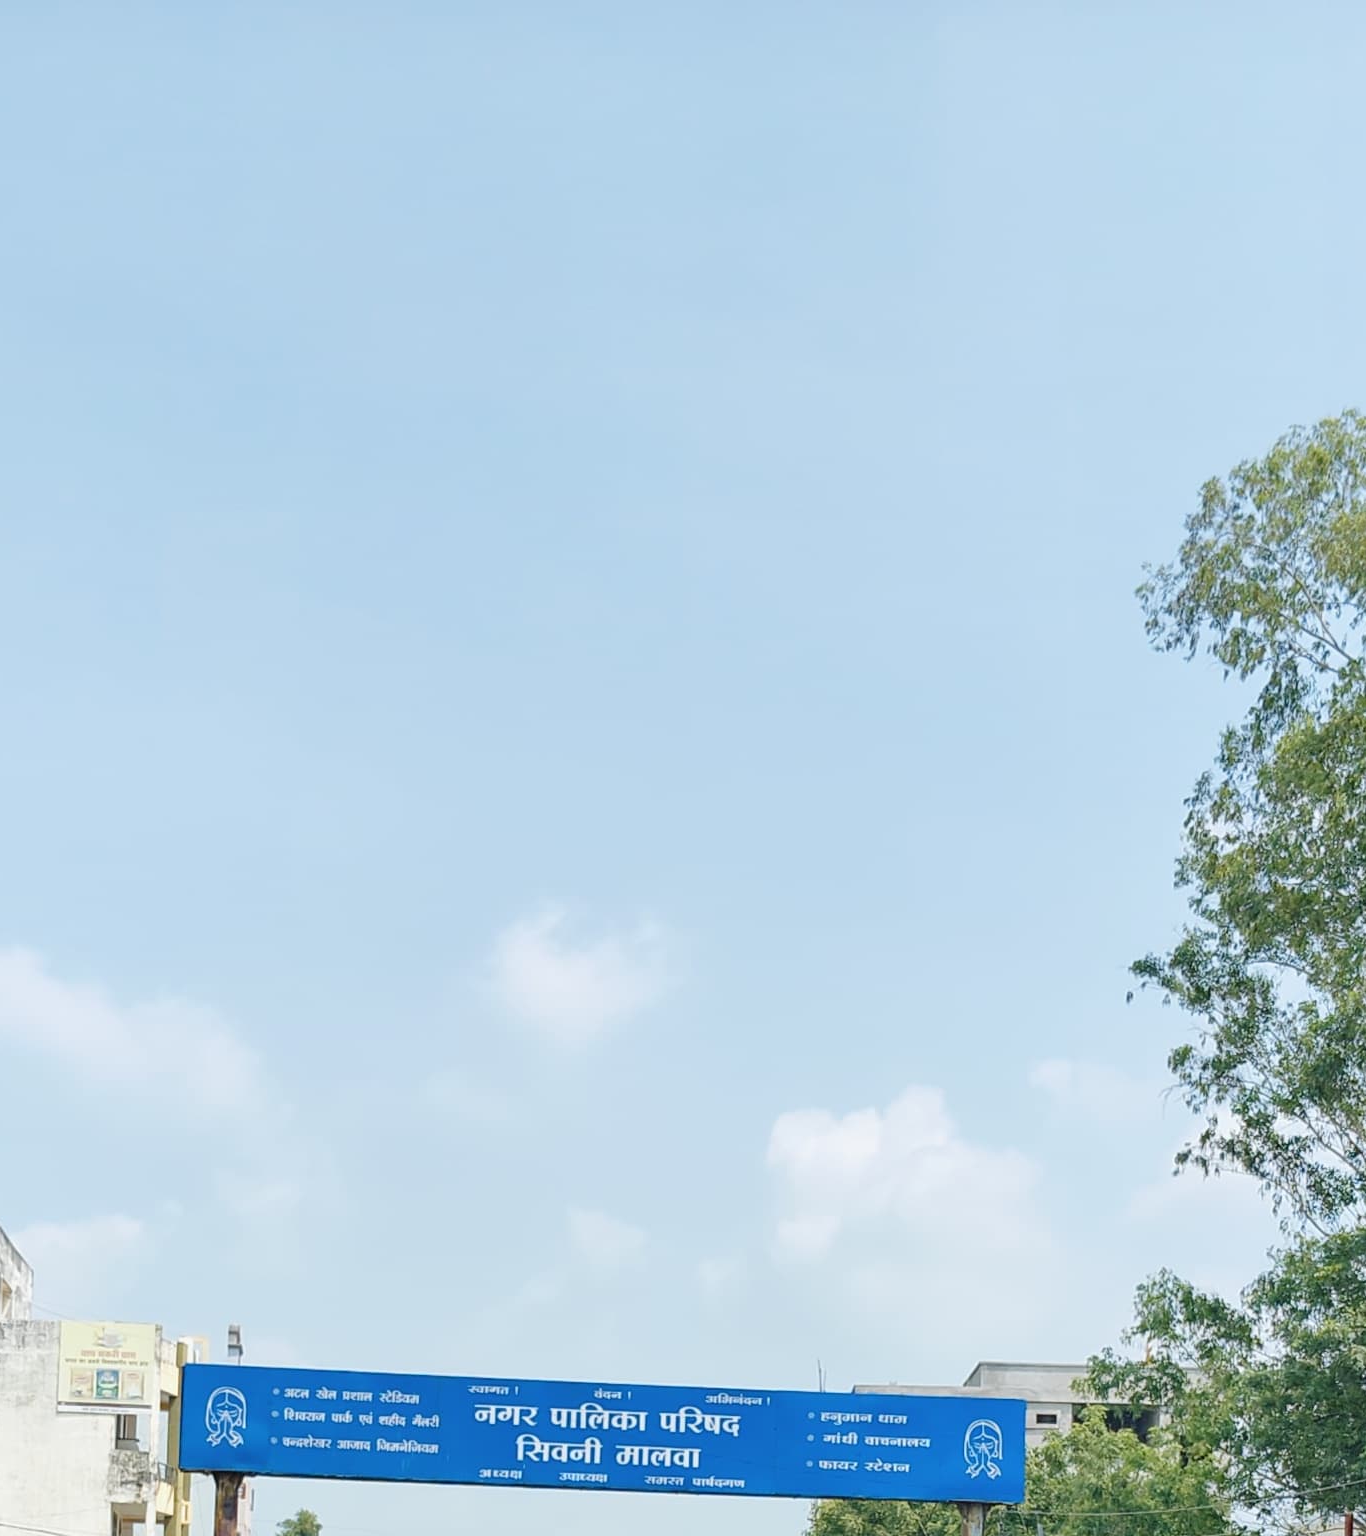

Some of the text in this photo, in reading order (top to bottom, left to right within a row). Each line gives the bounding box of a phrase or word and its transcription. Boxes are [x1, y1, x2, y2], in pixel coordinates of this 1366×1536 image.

[284, 1388, 309, 1399] अटल
[315, 1386, 337, 1400] खेल
[379, 1389, 420, 1405] स्टेडियम
[467, 1385, 510, 1395] स्वागत
[594, 1388, 622, 1400] वंदन
[705, 1392, 763, 1406] अभिनंदन
[284, 1407, 326, 1423] शिवराज
[331, 1410, 353, 1423] पार्क
[358, 1411, 373, 1426] एवं
[378, 1412, 406, 1427] शहीद
[475, 1402, 742, 1437] नगर पालिका परिषद
[820, 1412, 908, 1425] हनुमान धाम
[823, 1432, 931, 1448] गांधी वाचनालय
[515, 1434, 702, 1468] सिवनी मालवा
[818, 1458, 910, 1472] फायर स्टेशन
[478, 1469, 745, 1488] अध्यक्ष उपाध्यक्ष समस्त पार्षदगण
